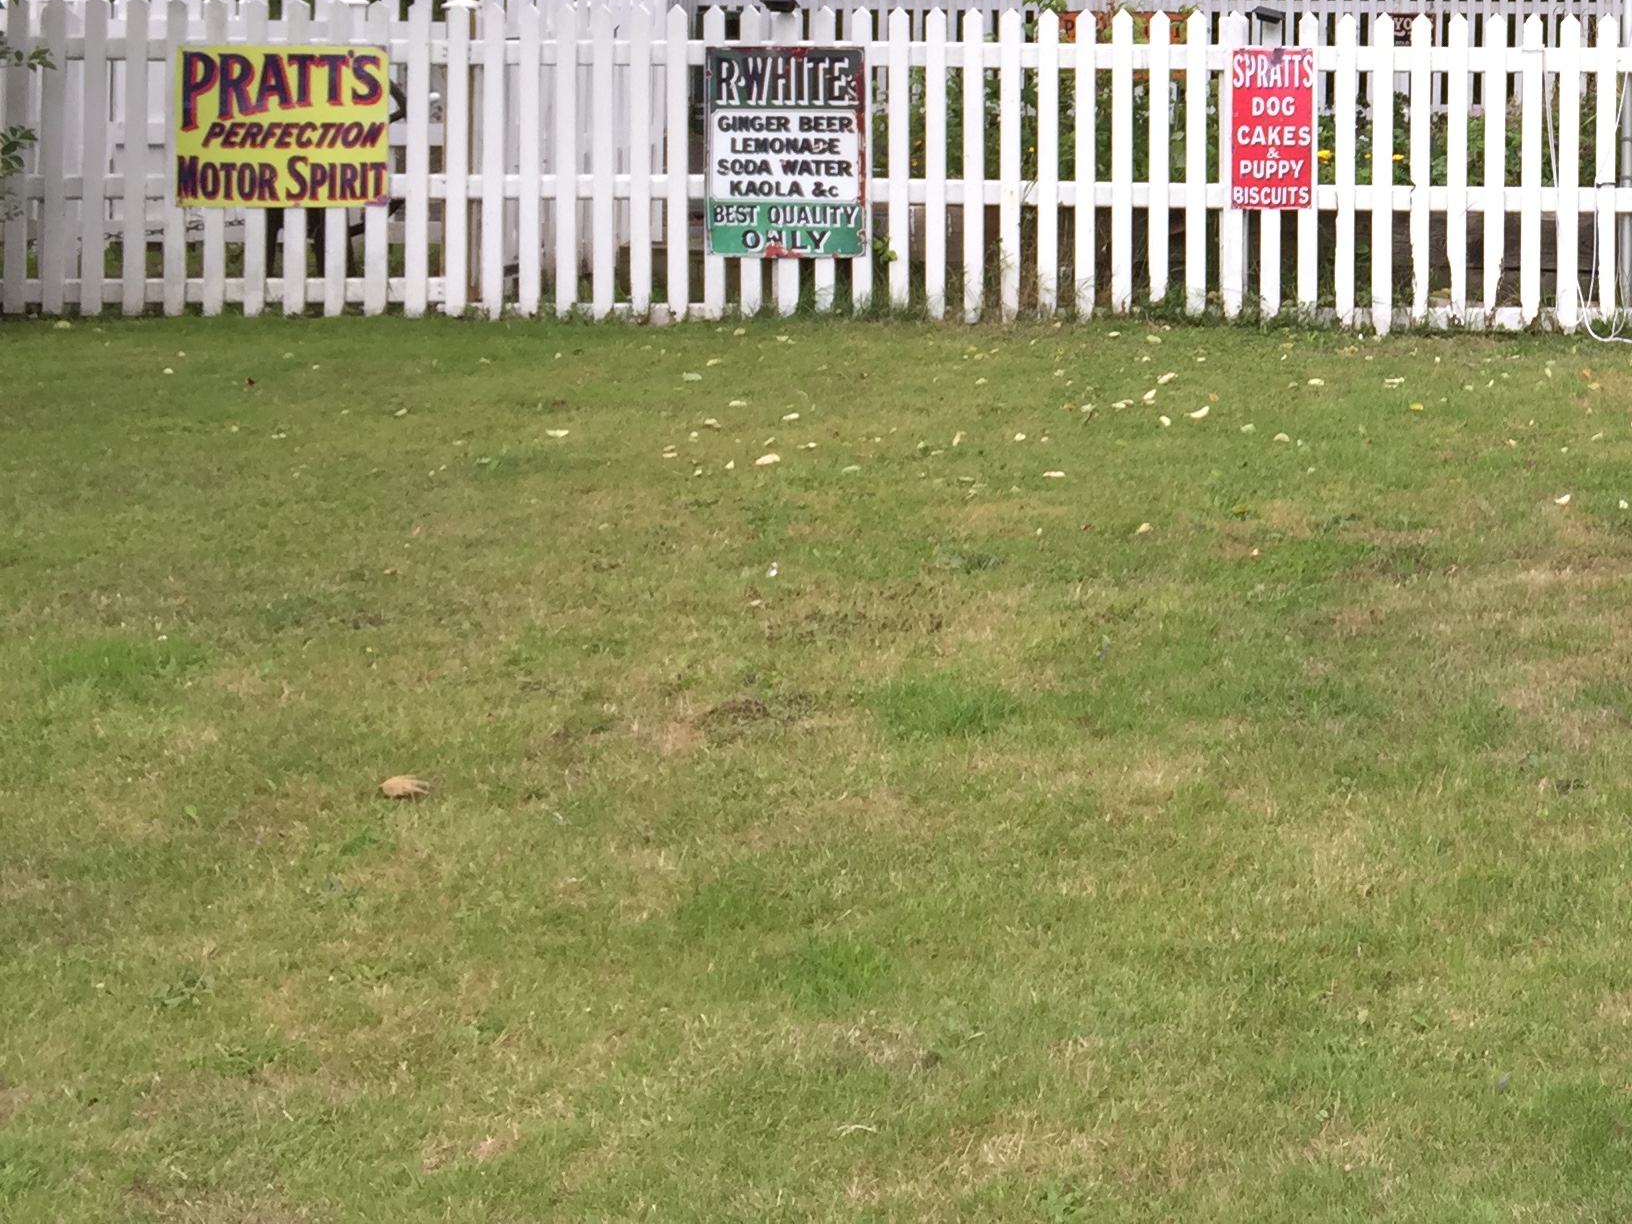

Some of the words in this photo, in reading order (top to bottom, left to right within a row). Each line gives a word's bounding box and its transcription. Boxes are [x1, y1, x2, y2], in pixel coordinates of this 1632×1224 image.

[180, 49, 384, 133] PRATT'S
[1251, 96, 1296, 117] DOG
[717, 115, 792, 133] GINGER
[798, 115, 855, 134] BEER
[201, 121, 386, 149] PERFECTION
[1237, 125, 1312, 147] CAKES
[730, 137, 842, 155] LEMONADE
[1266, 146, 1281, 159] &
[716, 158, 774, 176] SODA
[779, 159, 854, 177] WATER
[1239, 159, 1305, 179] PUPPY
[176, 154, 281, 202] MOTOR
[285, 155, 388, 202] SPIRIT
[729, 180, 805, 197] KAOLA
[1233, 186, 1309, 206] BISCUITS
[713, 204, 760, 227] BEST
[767, 205, 861, 228] QUALITY
[742, 229, 832, 254] ONLY
